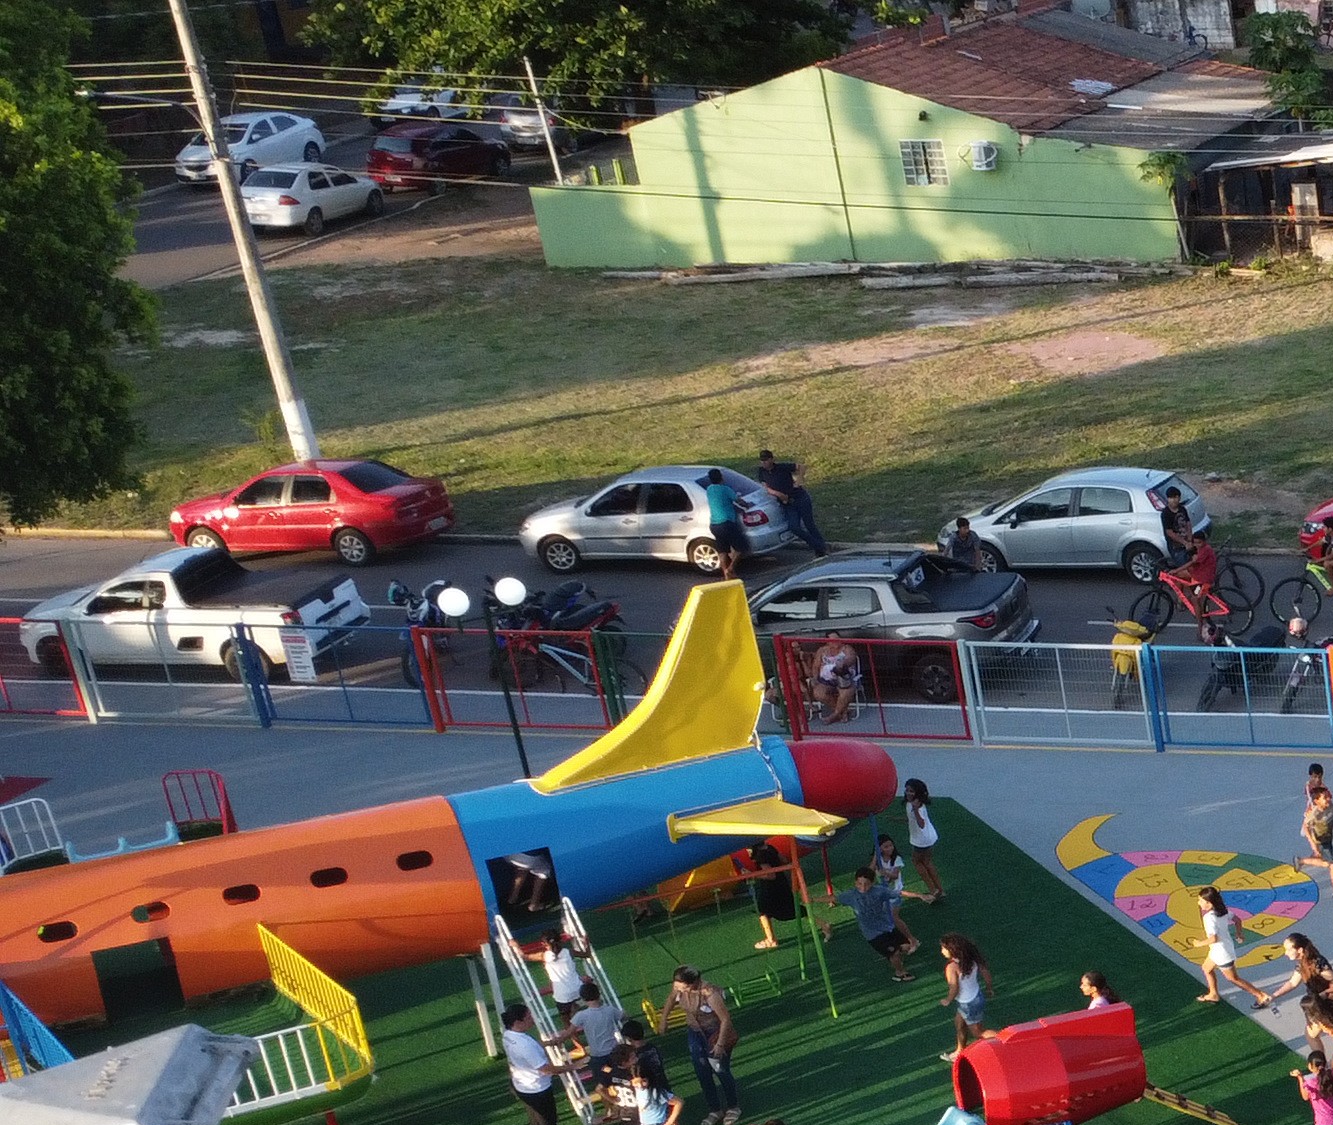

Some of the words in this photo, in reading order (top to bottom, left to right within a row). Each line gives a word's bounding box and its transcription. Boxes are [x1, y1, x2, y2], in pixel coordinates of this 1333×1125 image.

[1136, 873, 1168, 888] 13
[1127, 898, 1156, 911] 12
[1252, 918, 1275, 929] 8
